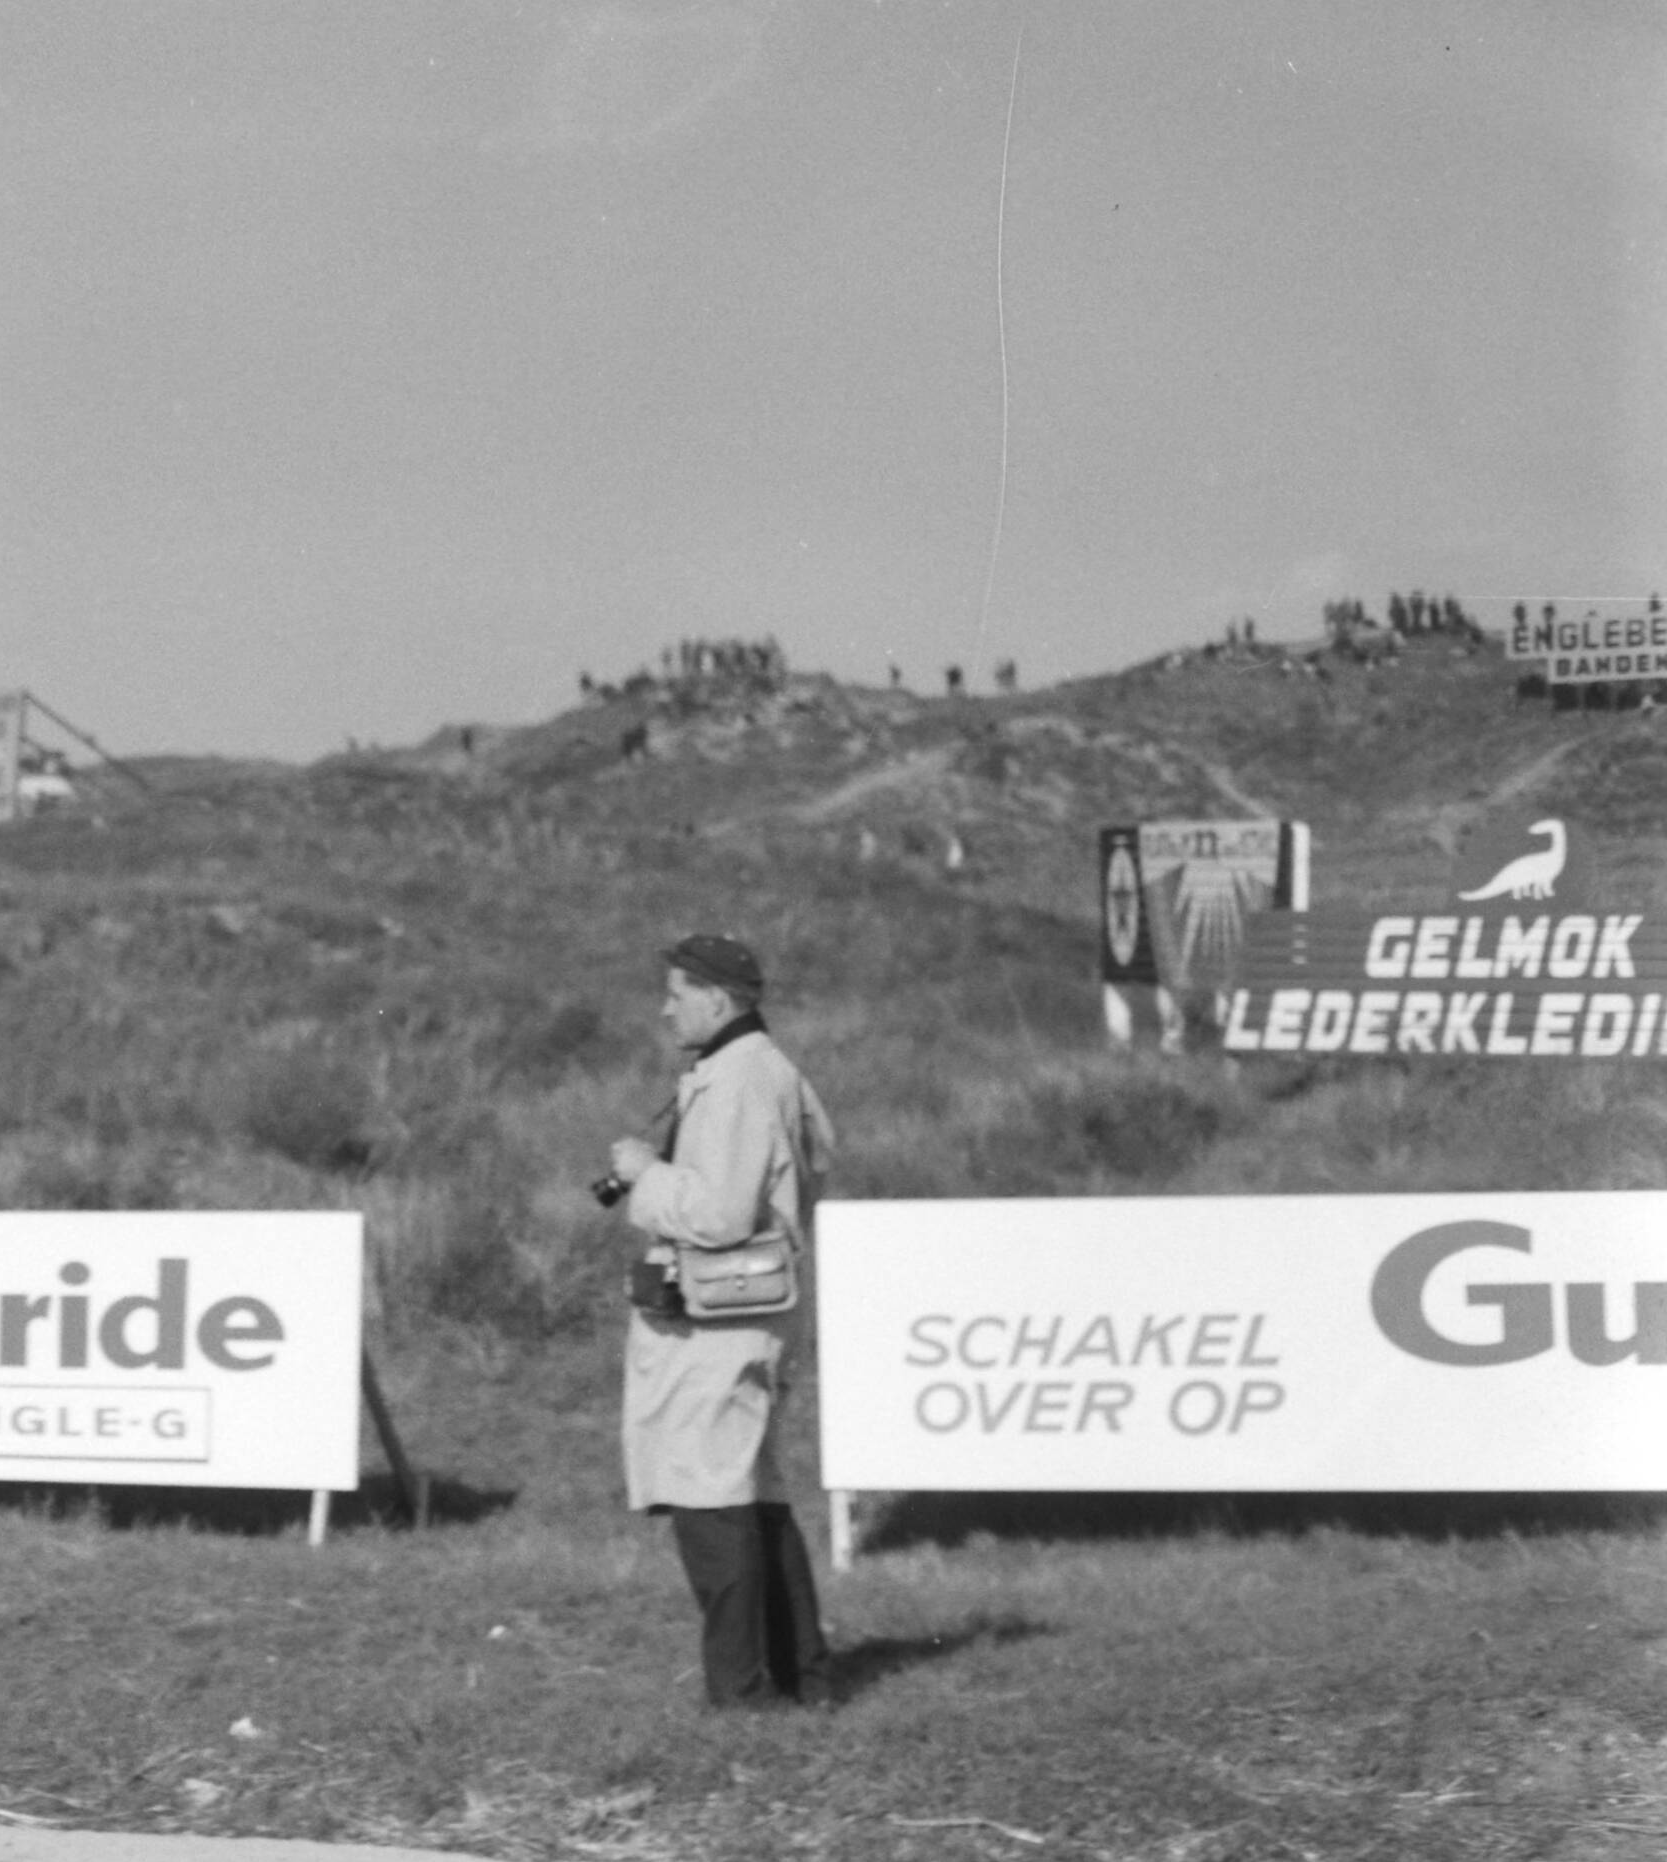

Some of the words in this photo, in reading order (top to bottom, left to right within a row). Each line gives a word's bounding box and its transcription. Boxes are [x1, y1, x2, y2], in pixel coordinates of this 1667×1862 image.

[1366, 915, 1644, 979] GELMOK
[1369, 1219, 1667, 1367] Gu
[904, 1313, 1282, 1370] SCHAKEL
[914, 1381, 1137, 1435] OVER
[1167, 1380, 1287, 1437] OP
